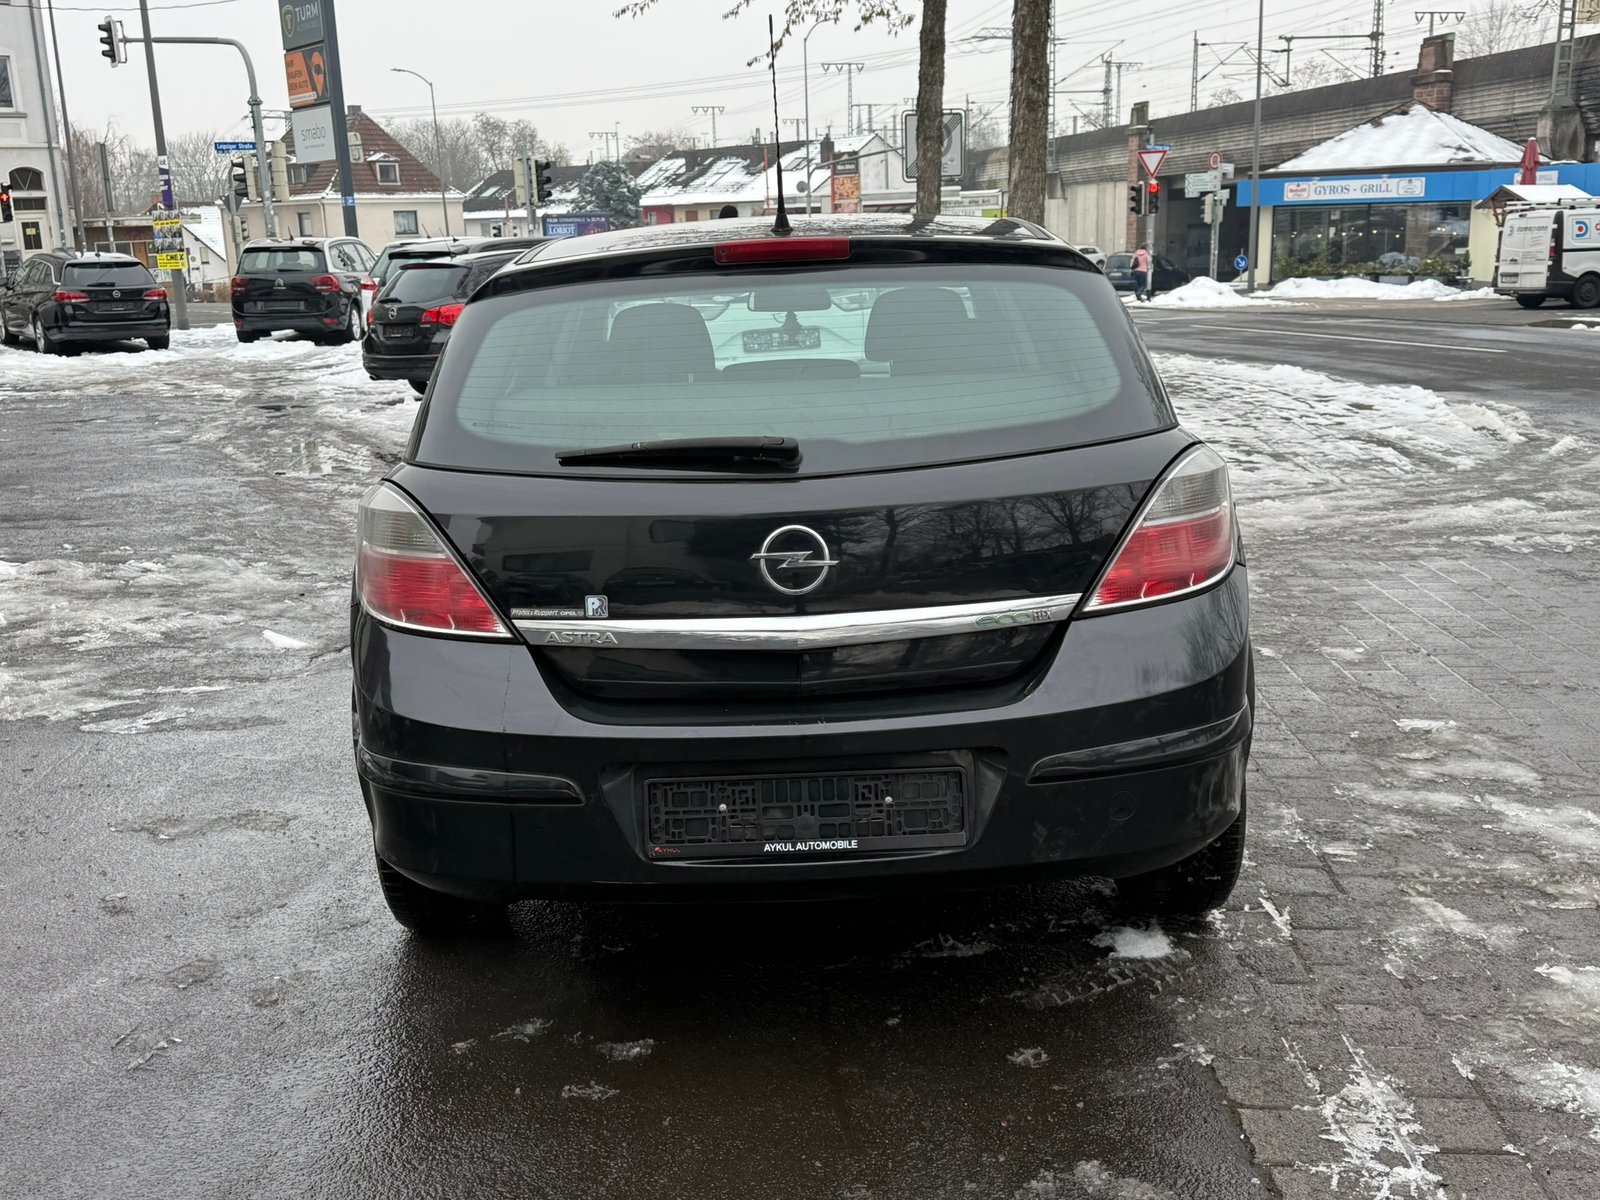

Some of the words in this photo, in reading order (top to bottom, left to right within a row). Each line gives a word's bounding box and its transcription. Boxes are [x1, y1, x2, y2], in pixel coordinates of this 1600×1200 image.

[295, 1, 319, 22] TURM
[301, 123, 326, 141] smabo
[216, 143, 237, 151] Leipziger
[1314, 184, 1350, 195] GYROS
[1360, 183, 1393, 194] GRILL
[549, 226, 576, 235] LORIOT
[545, 631, 618, 645] ASTRA
[763, 842, 795, 852] AYKUL
[795, 840, 859, 851] AUTOMOBILE
